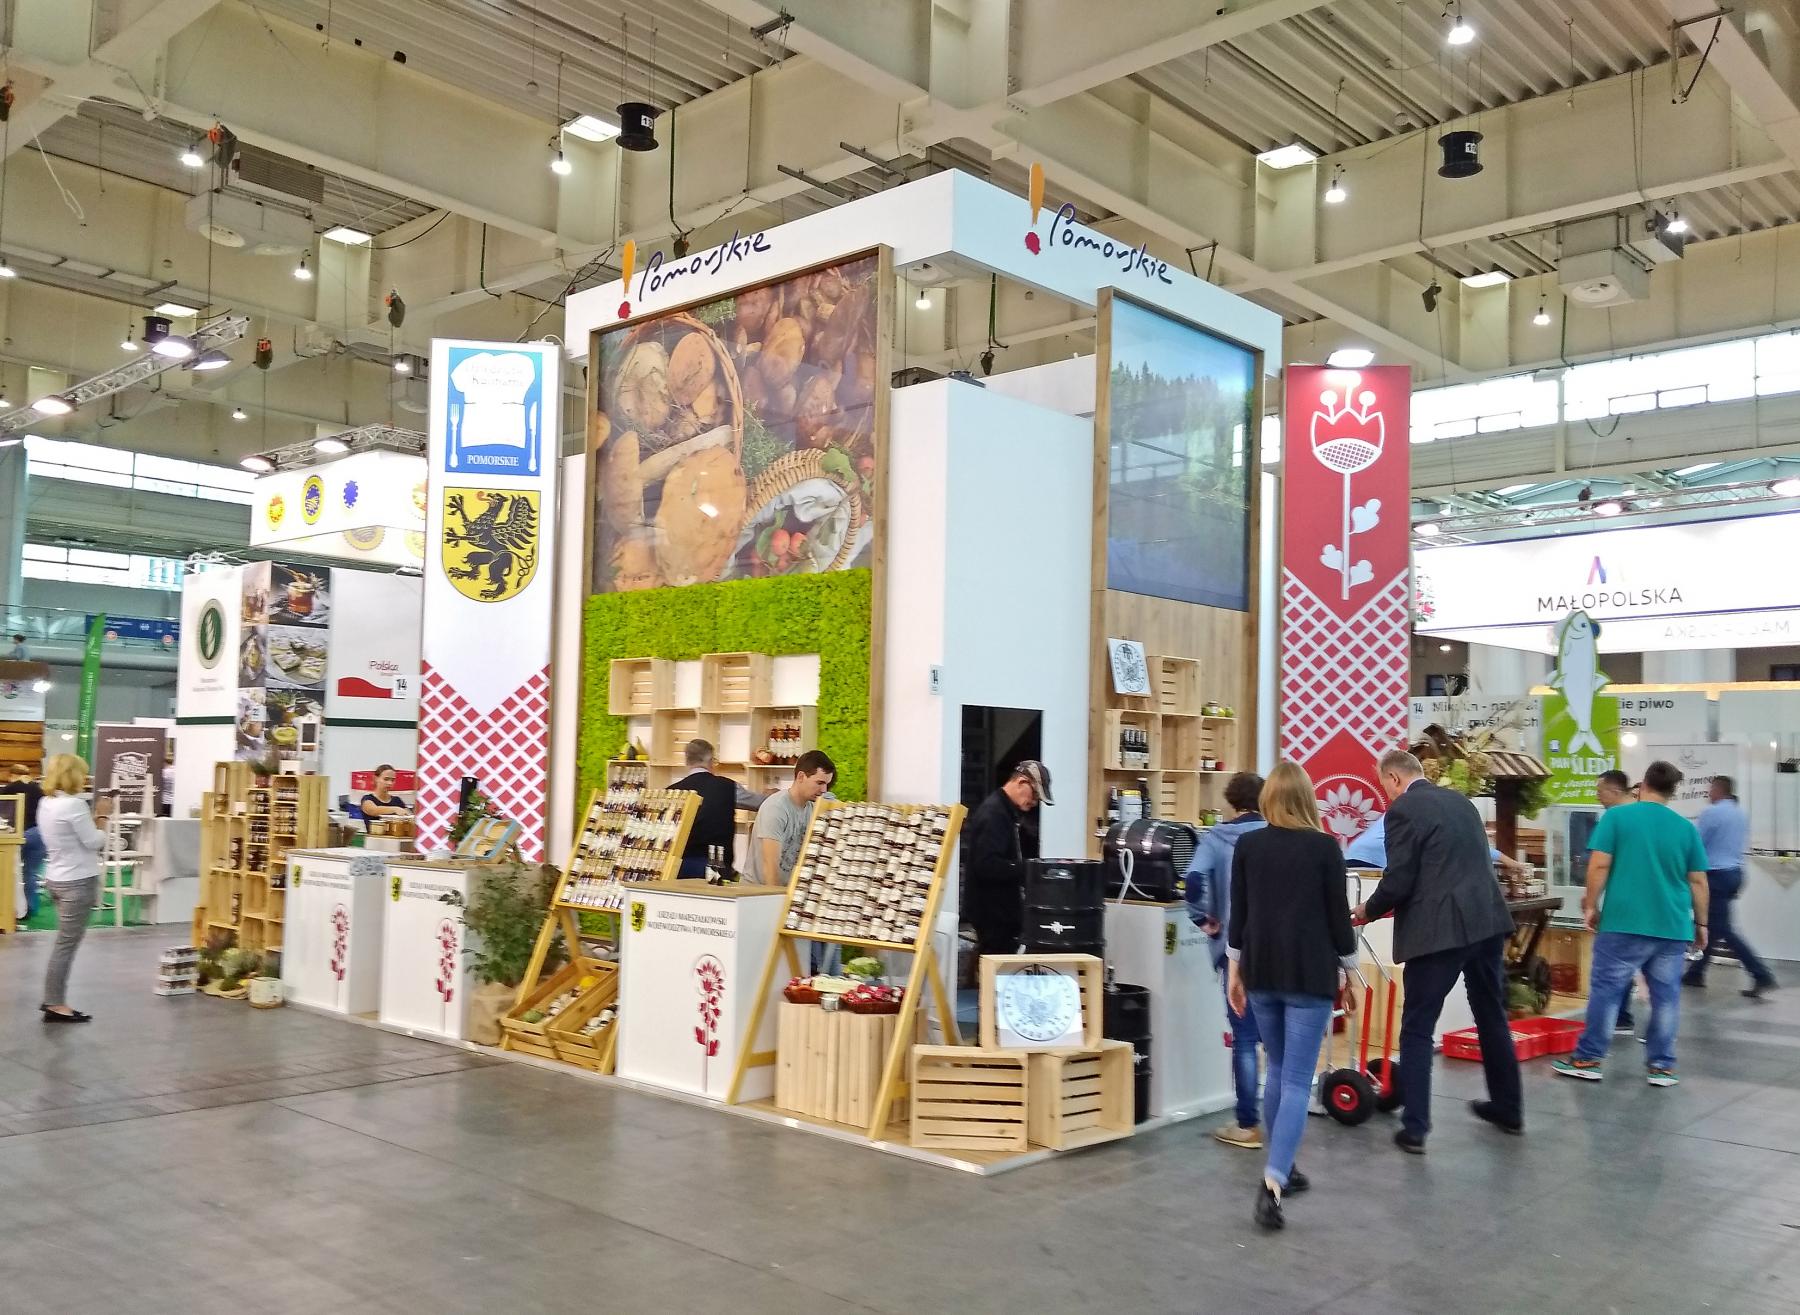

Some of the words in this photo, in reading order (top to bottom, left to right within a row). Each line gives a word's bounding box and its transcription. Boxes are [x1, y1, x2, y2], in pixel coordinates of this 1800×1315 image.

[1050, 202, 1172, 284] Pomorskie
[639, 229, 771, 302] Pomorskie
[467, 455, 519, 466] POMORSKIE
[1538, 588, 1683, 612] MAŁOPOLSKA
[1413, 702, 1424, 714] 14
[1639, 698, 1674, 711] piwo
